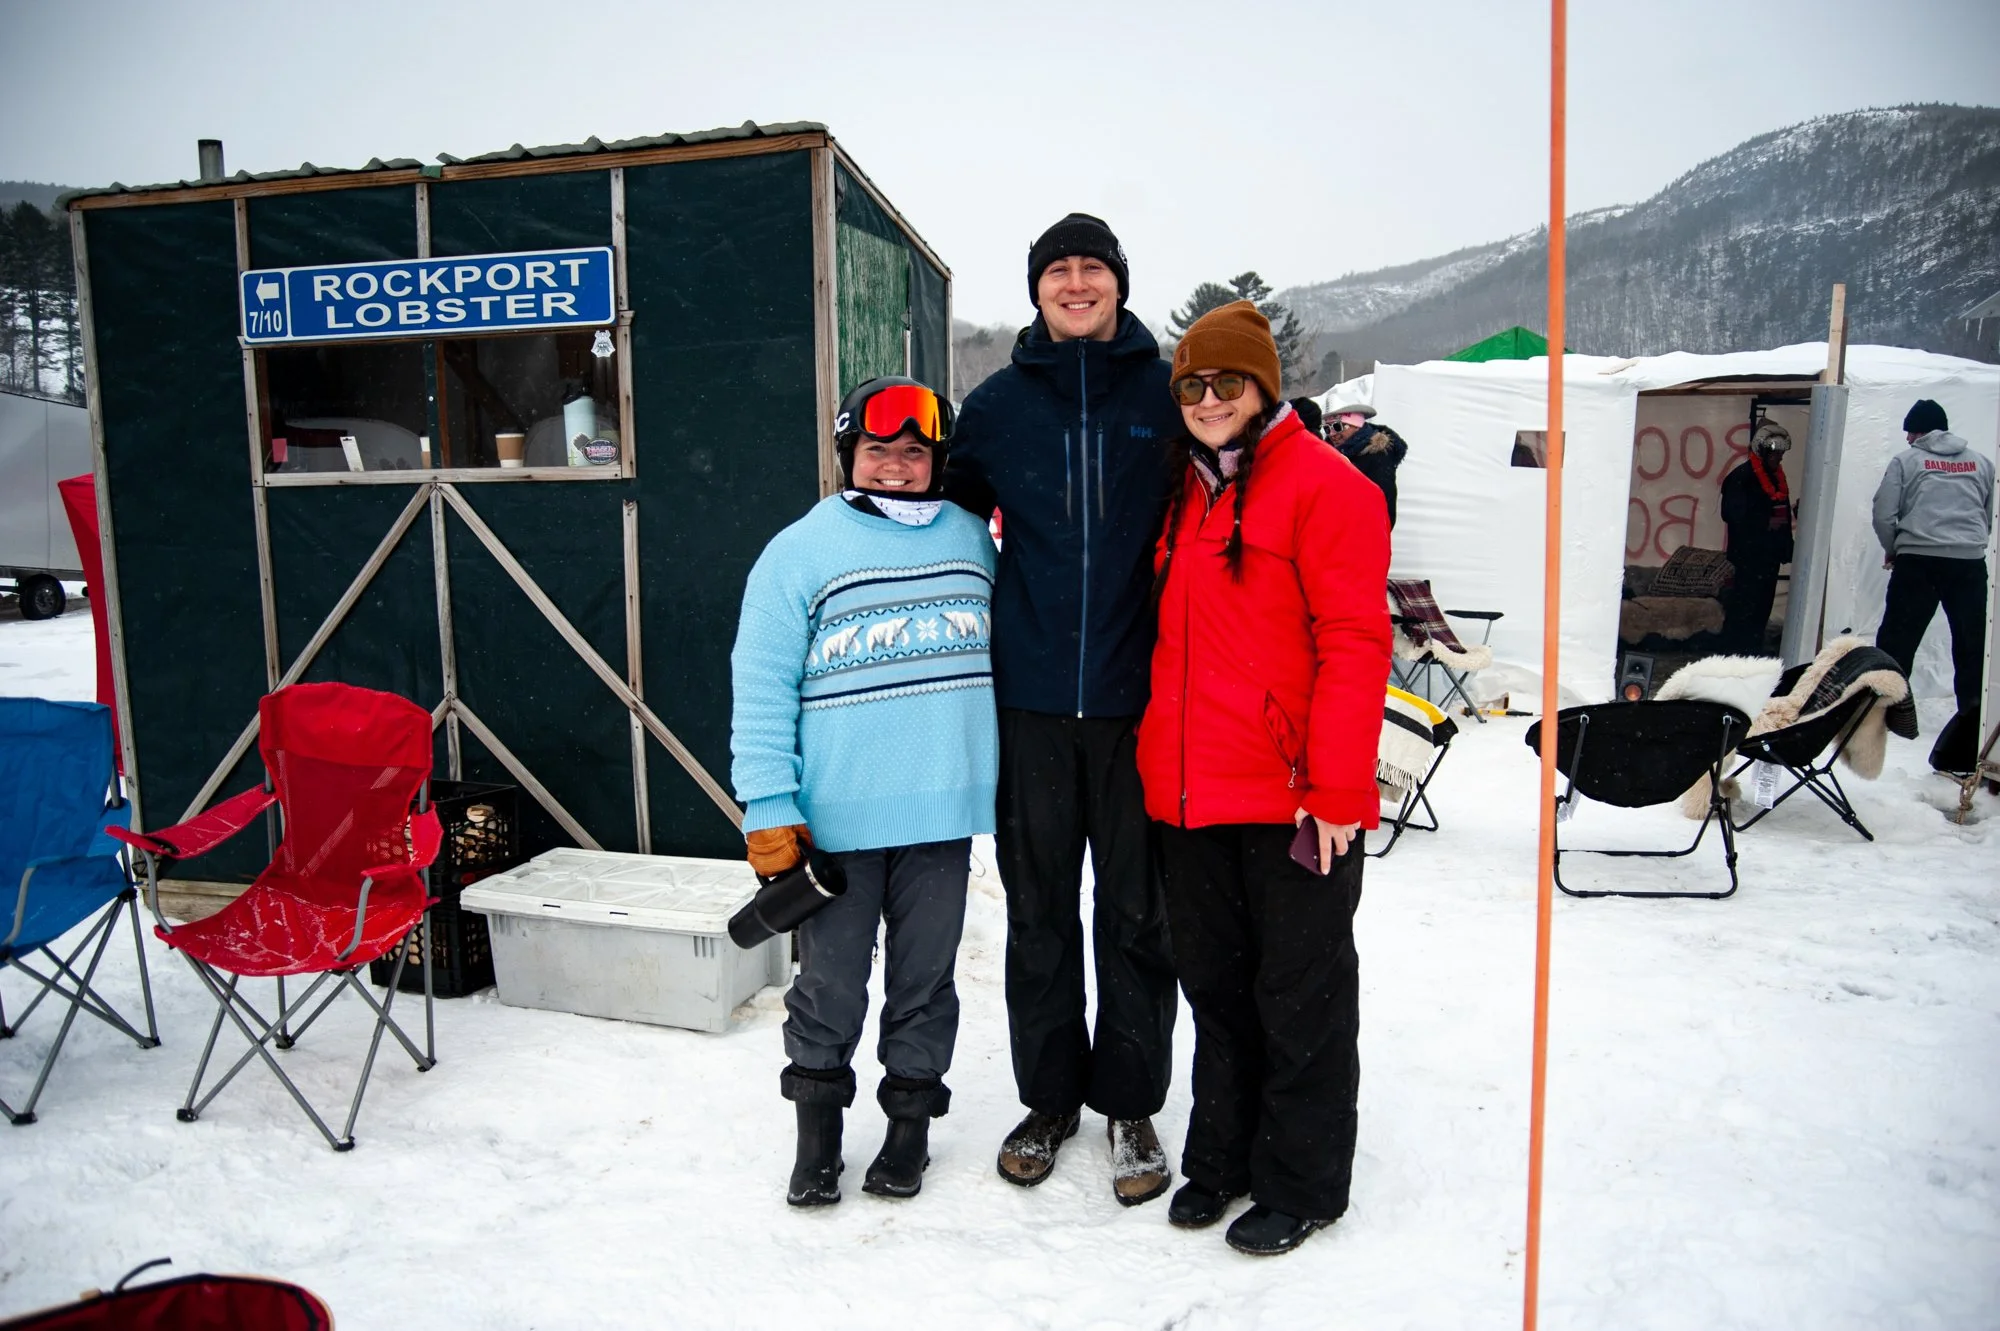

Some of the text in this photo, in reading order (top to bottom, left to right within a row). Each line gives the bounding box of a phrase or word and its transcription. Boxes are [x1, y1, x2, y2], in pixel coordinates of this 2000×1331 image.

[313, 258, 589, 301] ROCKPORT
[249, 309, 283, 334] 7/10
[326, 292, 579, 329] LOBSTER
